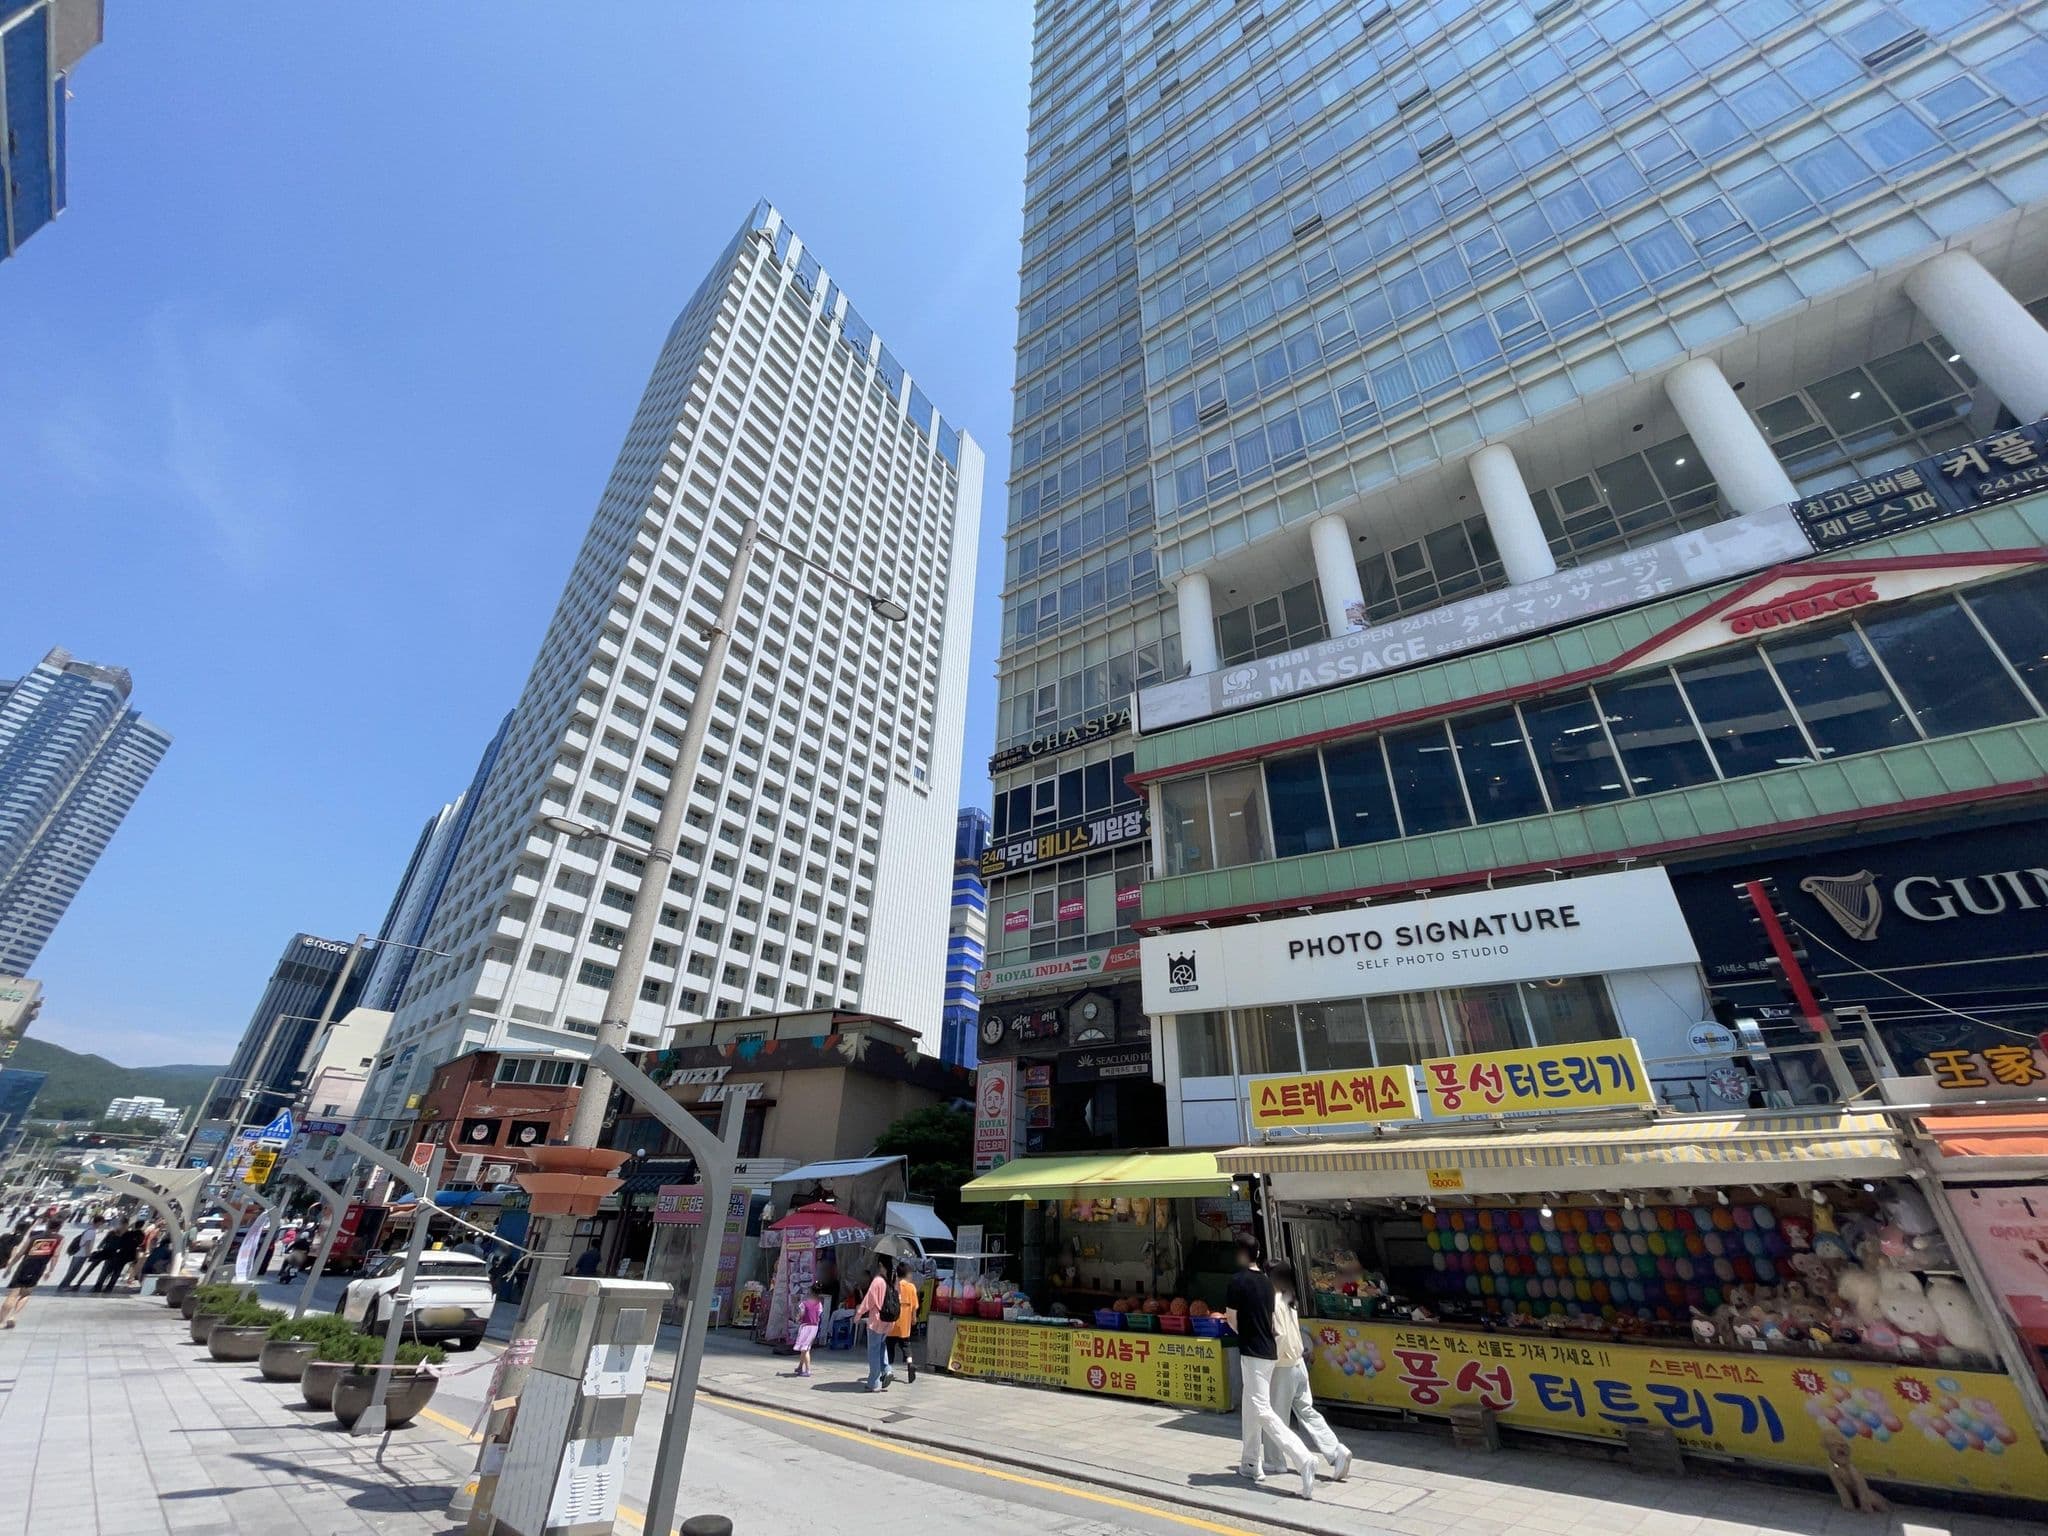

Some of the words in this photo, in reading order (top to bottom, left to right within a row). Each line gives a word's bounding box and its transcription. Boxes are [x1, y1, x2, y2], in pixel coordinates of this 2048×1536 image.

[1804, 470, 1924, 519] 최고급버블
[1817, 492, 1937, 539] 제트스파
[1634, 577, 1673, 599] 3F
[1731, 584, 1879, 635] OUTBACK
[1346, 626, 1395, 649] OPEN
[1401, 608, 1455, 634] 24시간
[1269, 637, 1429, 697] MASSAGE
[1028, 725, 1081, 756] CHA
[1085, 706, 1132, 736] SPA
[1007, 810, 1143, 867] 무인테니스게임장
[1288, 930, 1383, 960] PHOTO
[1396, 904, 1581, 947] SIGNATURE
[996, 968, 1035, 984] ROYAL
[1035, 962, 1073, 977] INDIA
[1356, 956, 1390, 971] SELF
[1396, 950, 1446, 967] PHOTO
[1452, 944, 1510, 961] STUDIO
[666, 1065, 733, 1086] FUZZY
[1929, 1044, 2043, 1088] 王家
[698, 1082, 764, 1103] NAL
[1260, 1074, 1406, 1118] 스트레스해소
[979, 1119, 1007, 1128] ROYAL
[979, 1128, 1005, 1137] INDIA
[1157, 1342, 1215, 1360] 스트레스해소
[1395, 1333, 1441, 1351] 스트레스
[1477, 1340, 1516, 1358] 선물도
[1519, 1344, 1548, 1362] 가져
[1553, 1346, 1594, 1366] 가세요
[1110, 1371, 1137, 1391] 없음
[1649, 1357, 1763, 1384] 스트레스해소
[1393, 1349, 1516, 1411] 풍선
[1529, 1371, 1785, 1443] 터트리기
